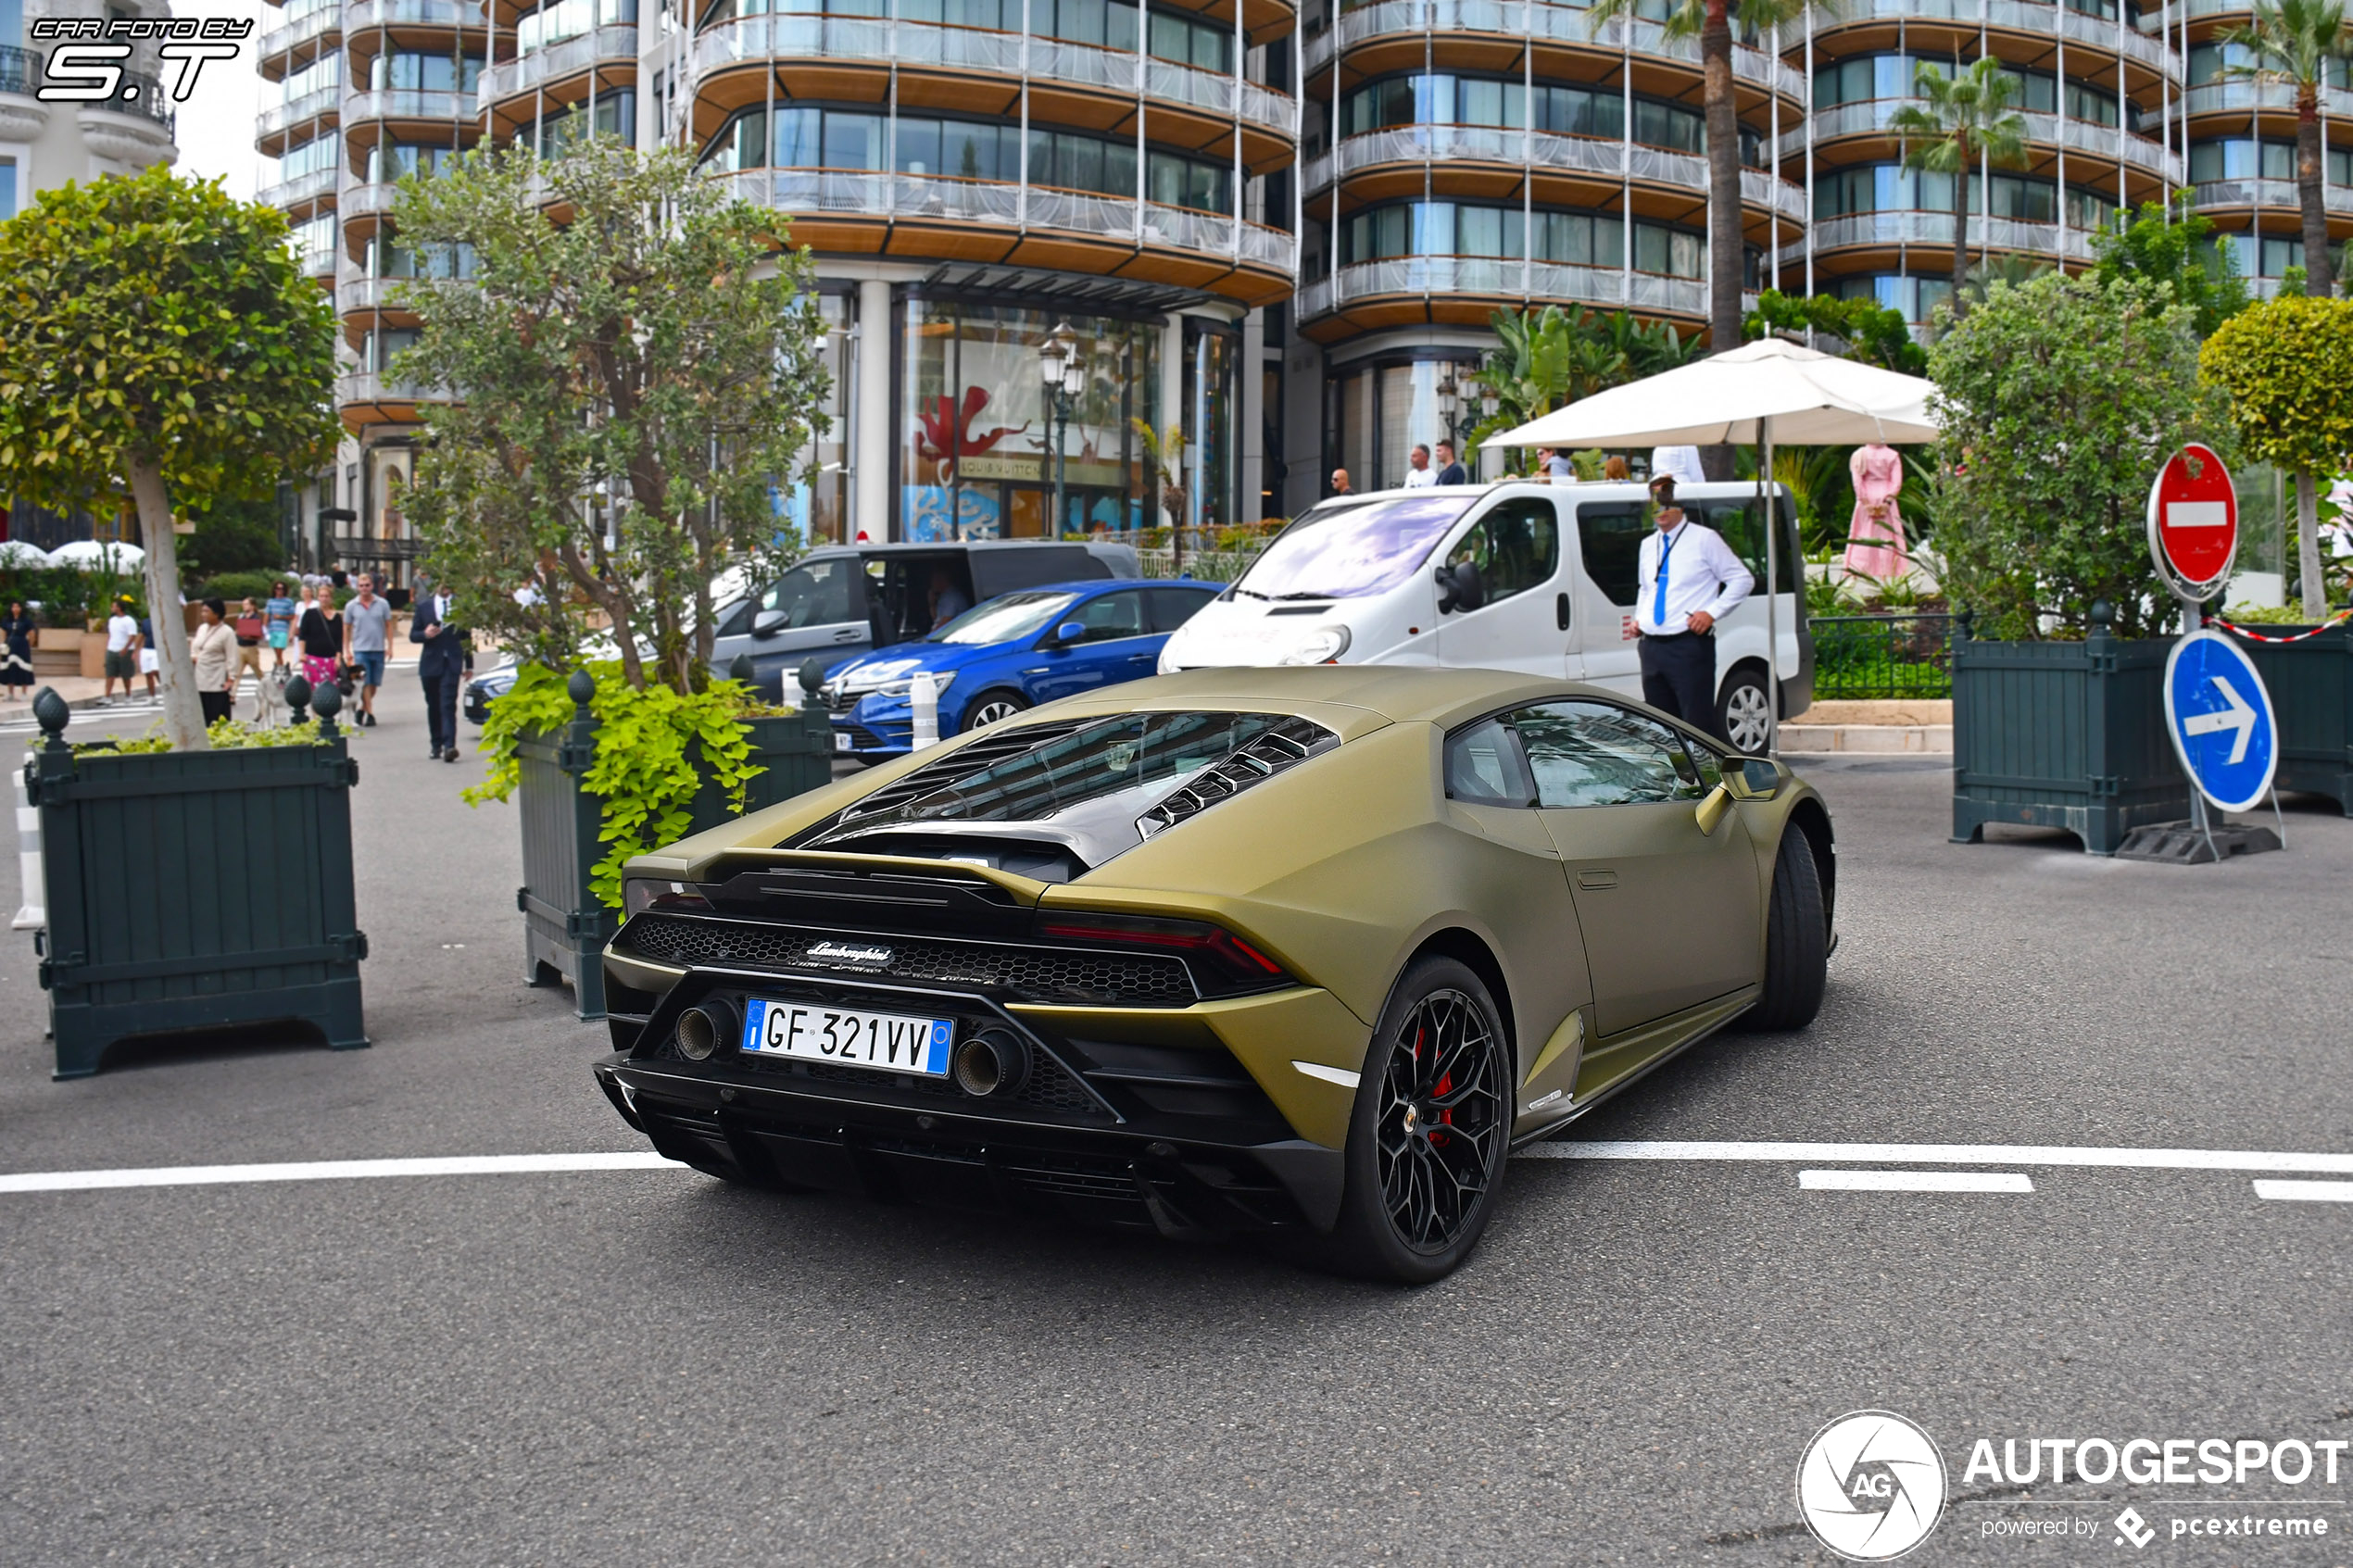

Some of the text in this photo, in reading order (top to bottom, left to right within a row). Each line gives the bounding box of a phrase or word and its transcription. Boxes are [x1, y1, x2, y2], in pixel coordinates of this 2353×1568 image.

[961, 462, 1040, 475] LOUIS VUITTON
[806, 941, 891, 962] Lamborghini
[767, 1007, 809, 1051] GF
[820, 1012, 927, 1066] 321VV
